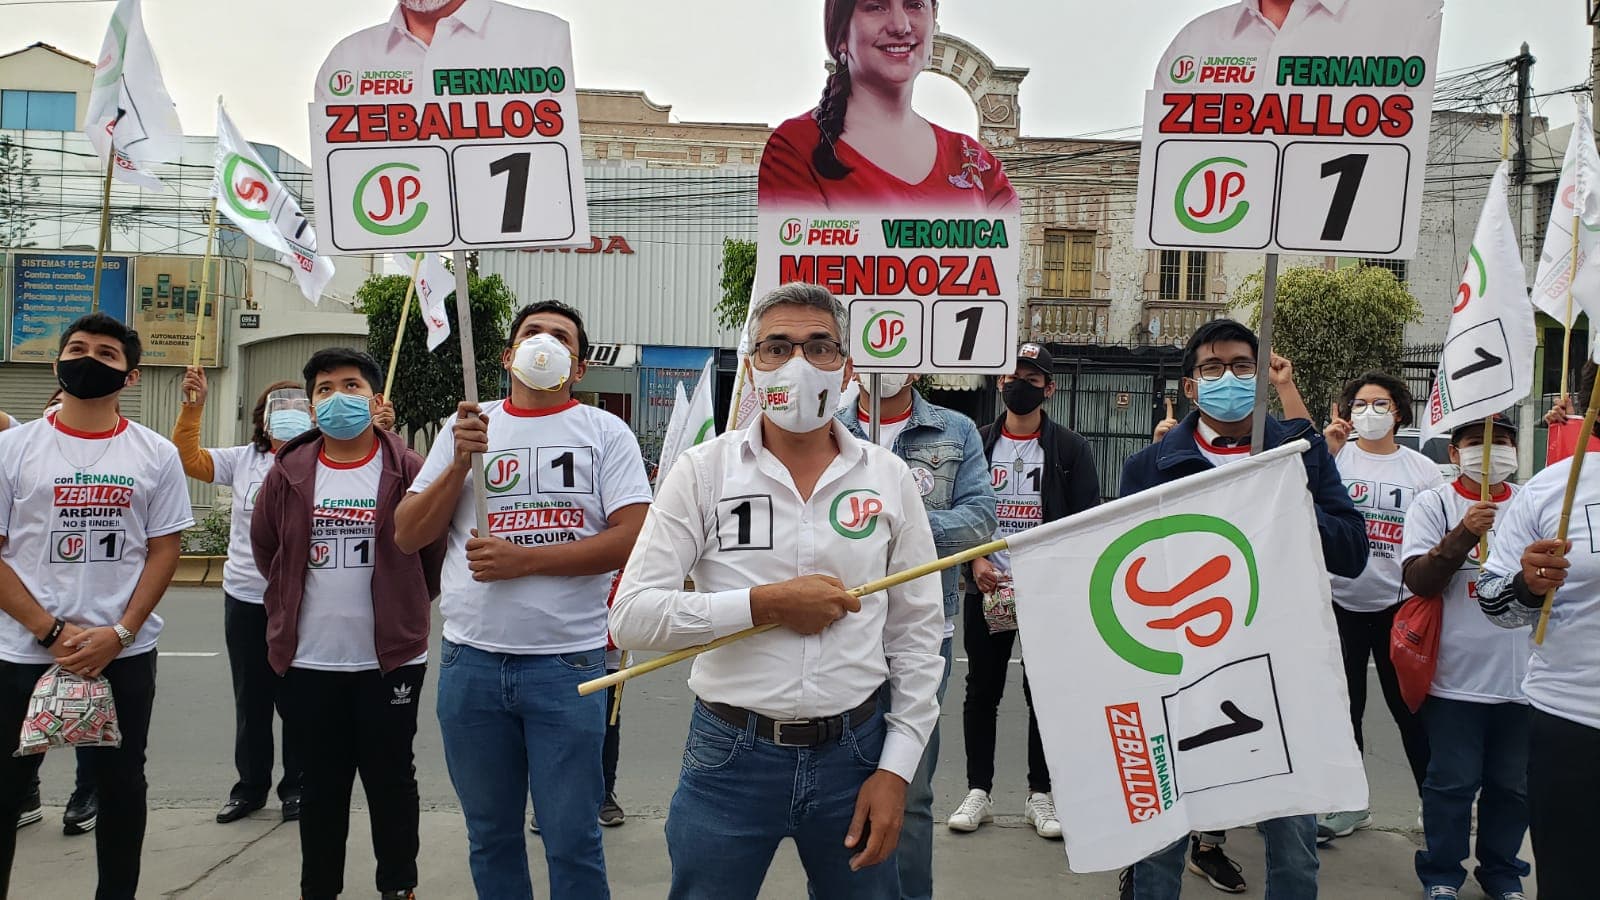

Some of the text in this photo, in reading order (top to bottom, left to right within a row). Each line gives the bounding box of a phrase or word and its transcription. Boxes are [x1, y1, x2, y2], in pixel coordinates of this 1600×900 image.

[1204, 57, 1245, 65] JUNTOS
[1276, 55, 1425, 87] FERNANDO
[360, 79, 413, 95] PERÚ
[361, 71, 402, 79] JUNTOS
[433, 66, 566, 96] FERNANDO
[1199, 66, 1257, 83] PERÚ
[325, 99, 565, 143] ZEBALLOS
[1159, 93, 1413, 138] ZEBALLOS
[489, 152, 532, 234] 1
[1319, 153, 1369, 241] 1
[810, 220, 849, 228] JUNTOS
[881, 218, 1009, 249] VERONICA
[807, 229, 859, 245] PERÚ
[21, 259, 66, 268] SISTEMAS
[68, 260, 80, 268] DE
[24, 270, 86, 280] Contra incendio
[779, 255, 1001, 296] MENDOZA
[955, 306, 984, 361] 1
[1451, 347, 1502, 380] 1
[817, 389, 828, 417] 1
[75, 472, 135, 486] FERNANDO
[551, 451, 575, 488] 1
[1026, 467, 1041, 492] 1
[323, 498, 376, 508] FERNAND
[514, 501, 572, 510] FERNANDO
[1389, 488, 1402, 508] 1
[490, 510, 583, 531] ZEBALLOS
[731, 501, 751, 544] 1
[996, 506, 1043, 518] EBALLOS
[999, 520, 1039, 529] REQUIPA
[99, 533, 116, 558] 1
[505, 531, 576, 545] AREQUIPA
[354, 540, 369, 563] 1
[1178, 700, 1264, 752] 1
[1110, 706, 1160, 822] ZEBALLOS
[1150, 734, 1172, 810] FERNANDO
